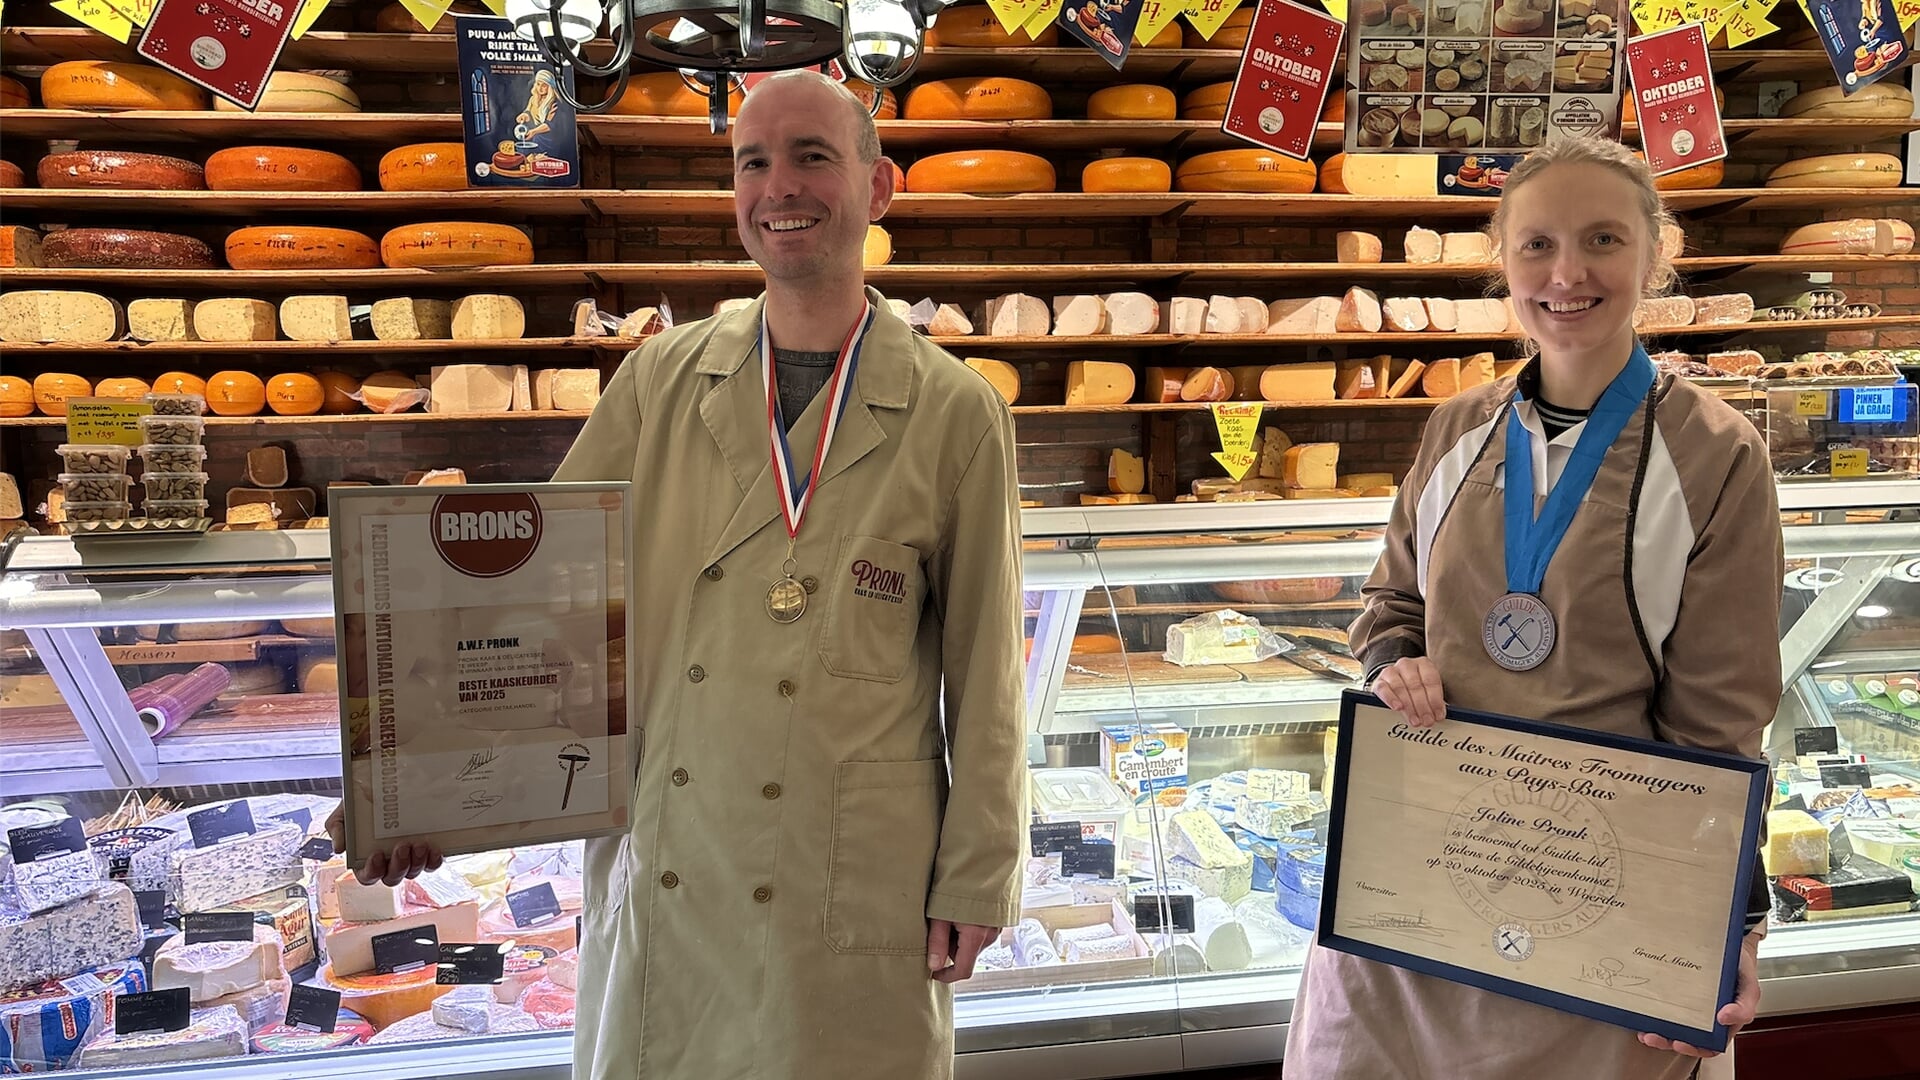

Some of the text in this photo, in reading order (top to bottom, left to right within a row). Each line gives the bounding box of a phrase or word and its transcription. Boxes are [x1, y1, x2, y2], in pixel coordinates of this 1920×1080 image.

[467, 29, 495, 39] PUUR
[487, 41, 514, 51] RIJKE
[480, 51, 546, 62] VOLLE SMAAK.
[1253, 47, 1322, 83] OKTOBER
[1642, 75, 1705, 103] OKTOBER
[1856, 394, 1882, 404] PINNEN
[1855, 404, 1891, 415] JA GRAAG
[440, 510, 534, 541] BRONS
[371, 524, 392, 611] NEDERLANDS
[851, 560, 907, 597] PRONK
[1502, 599, 1537, 613] GUILDE
[375, 613, 394, 688] NATIONAAL
[457, 637, 520, 651] A.W.F. PRONK
[117, 650, 176, 660] Hessen
[459, 674, 558, 692] BESTE KAASKEURDER
[459, 689, 506, 702] VAN 2025
[459, 706, 492, 714] CATEGORIE
[1387, 722, 1707, 796] Guilde des Maîtres Fromagers
[1125, 770, 1139, 780] en
[1459, 762, 1617, 801] aux Pays-Bas
[1470, 806, 1525, 827] Joline
[1530, 816, 1588, 841] Pronk
[87, 828, 170, 843] OQUEFORT
[1443, 843, 1483, 859] tijdens
[1486, 850, 1501, 863] de
[1450, 828, 1609, 868] is benoemd tot Guilde-lid
[1356, 880, 1397, 897] Voorzitter
[1426, 857, 1625, 909] op 20 oktober 2025 in Woerden
[279, 916, 307, 940] Agur
[1632, 946, 1665, 961] Grand
